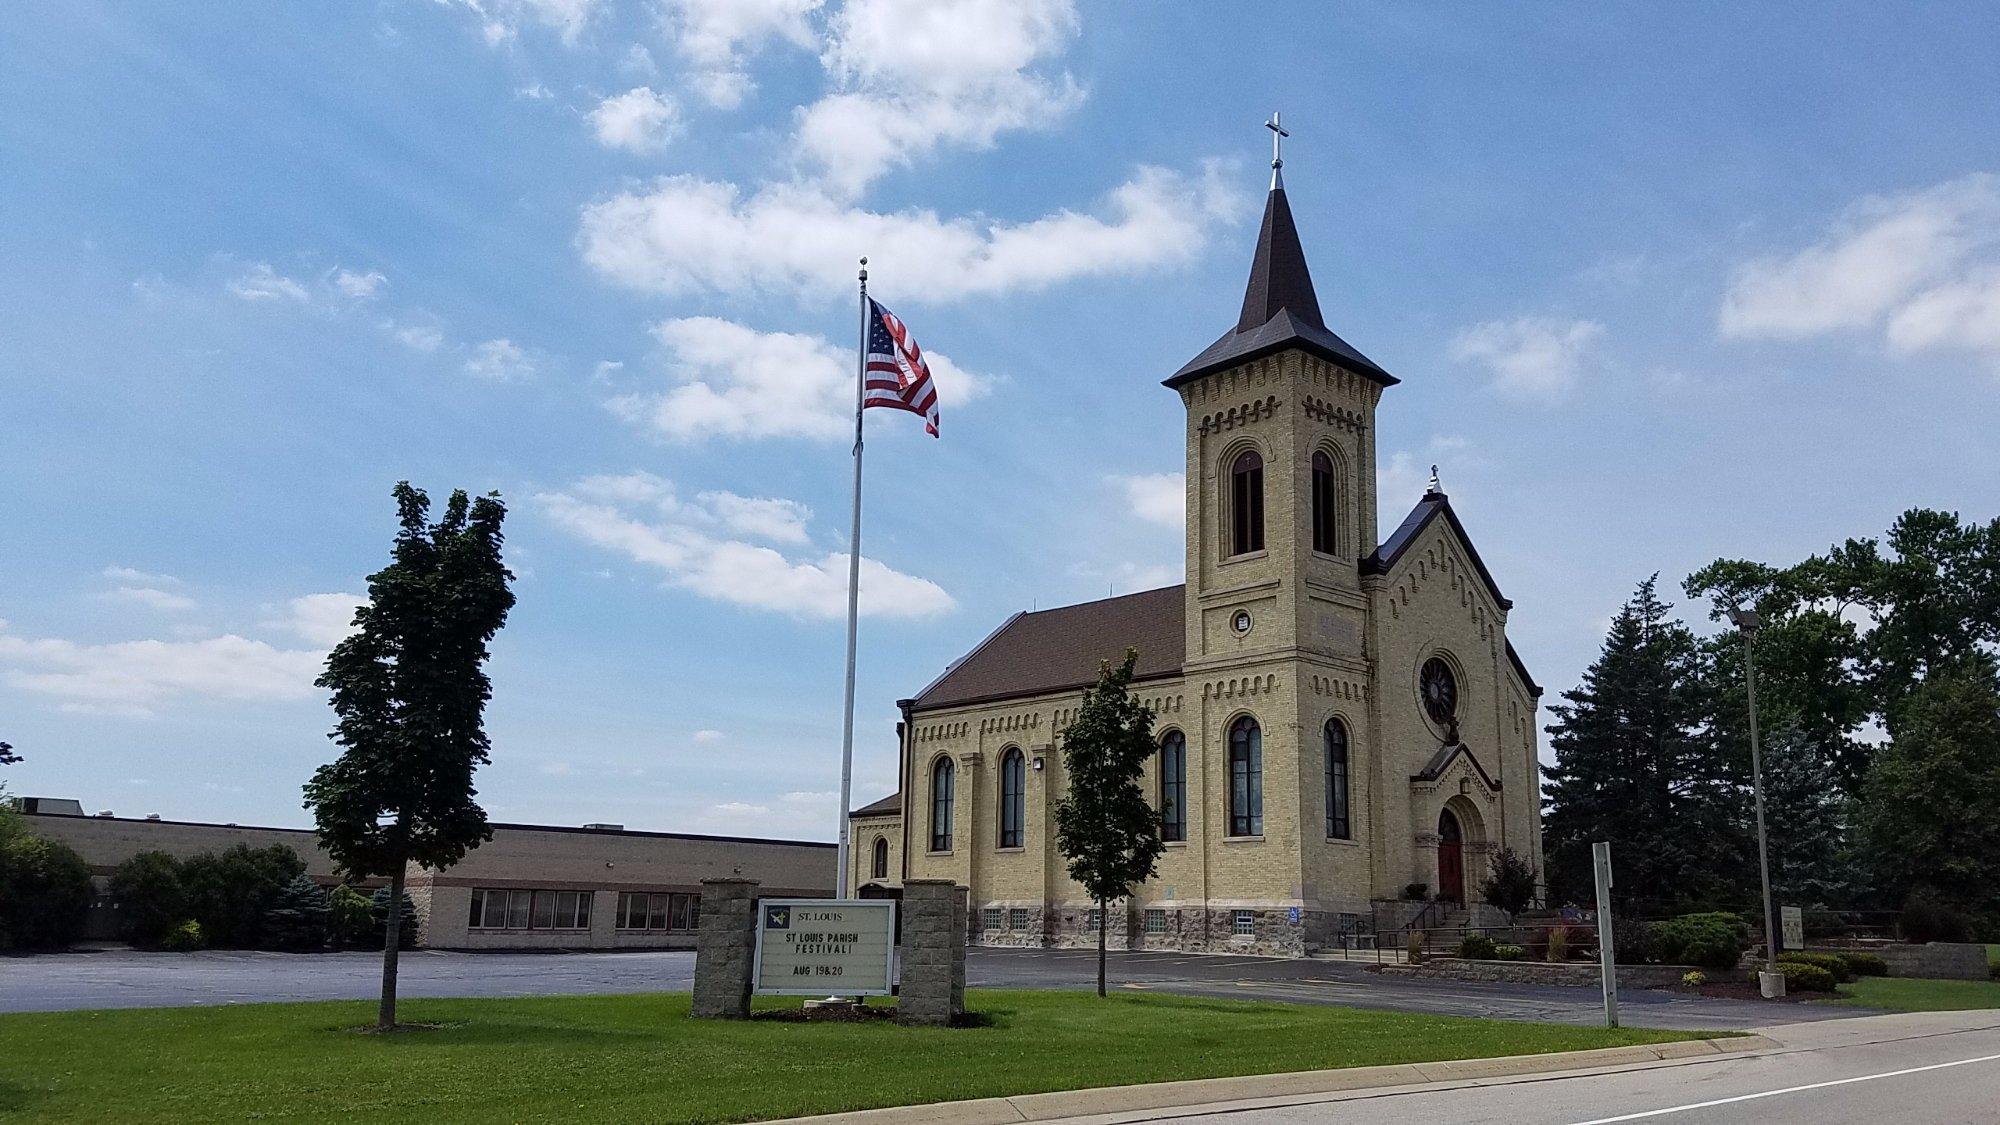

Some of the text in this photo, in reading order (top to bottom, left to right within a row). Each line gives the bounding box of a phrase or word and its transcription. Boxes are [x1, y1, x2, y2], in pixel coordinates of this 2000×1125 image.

[798, 912, 843, 921] ST. LOUIS
[785, 933, 859, 943] ST LOUIS PARISH
[793, 966, 811, 975] AUG
